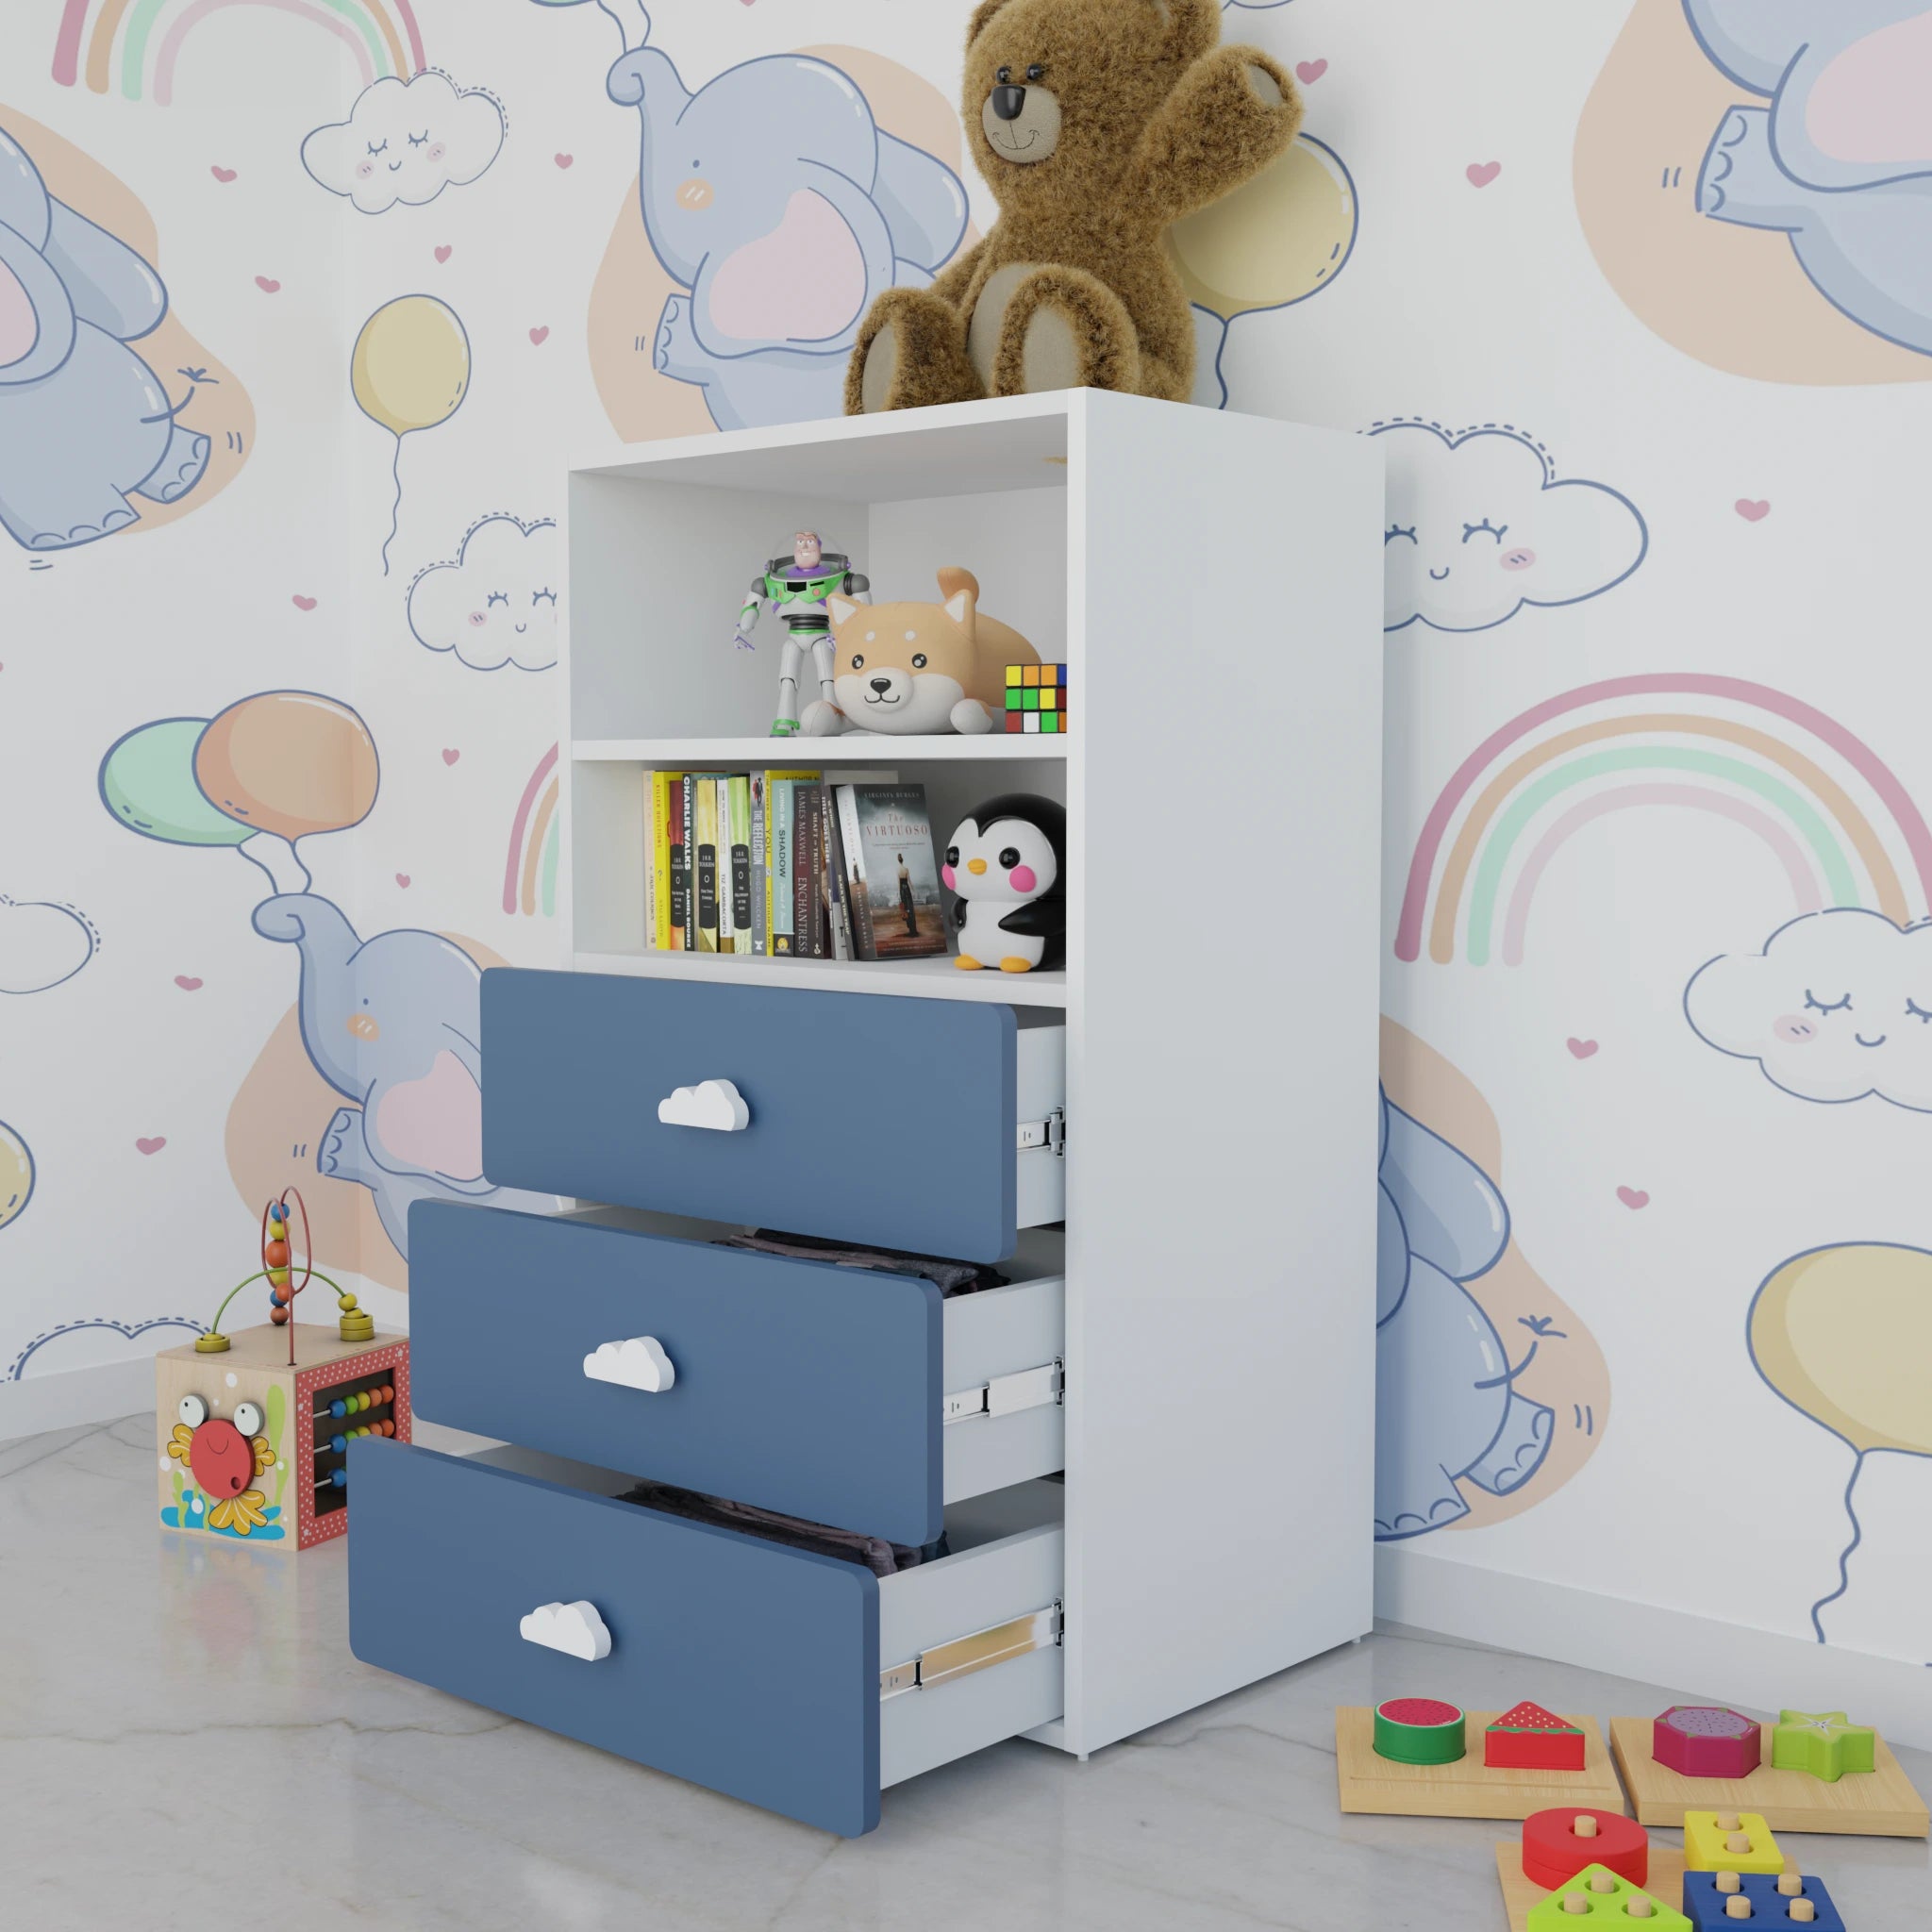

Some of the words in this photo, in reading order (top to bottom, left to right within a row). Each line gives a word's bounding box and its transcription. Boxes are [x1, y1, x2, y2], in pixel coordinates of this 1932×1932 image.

[753, 810, 763, 822] THE
[797, 791, 807, 820] JAMES
[888, 813, 906, 823] The
[752, 823, 764, 865] REFLECTION
[798, 822, 807, 866] MAXWELL
[866, 824, 929, 837] VIRTUOSO
[797, 876, 808, 953] ENCHANTRESS
